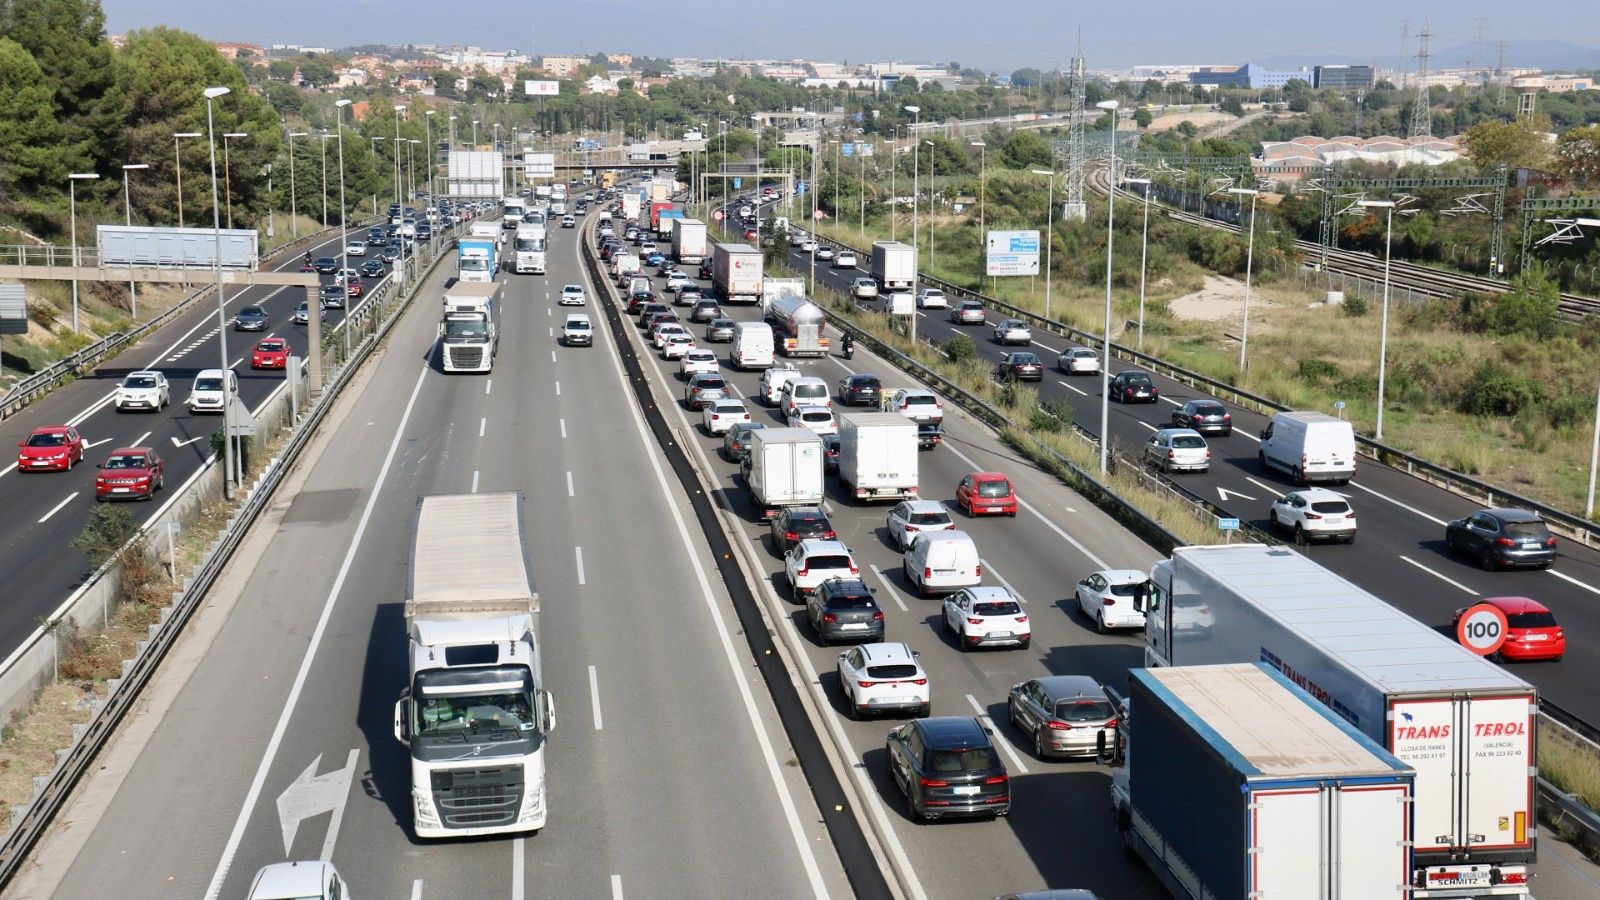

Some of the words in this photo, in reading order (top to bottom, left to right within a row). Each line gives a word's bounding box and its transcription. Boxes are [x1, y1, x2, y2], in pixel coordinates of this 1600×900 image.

[1466, 622, 1499, 638] 100
[1283, 663, 1306, 690] TRANS
[1397, 725, 1450, 740] TRANS
[1474, 722, 1525, 736] TEROL
